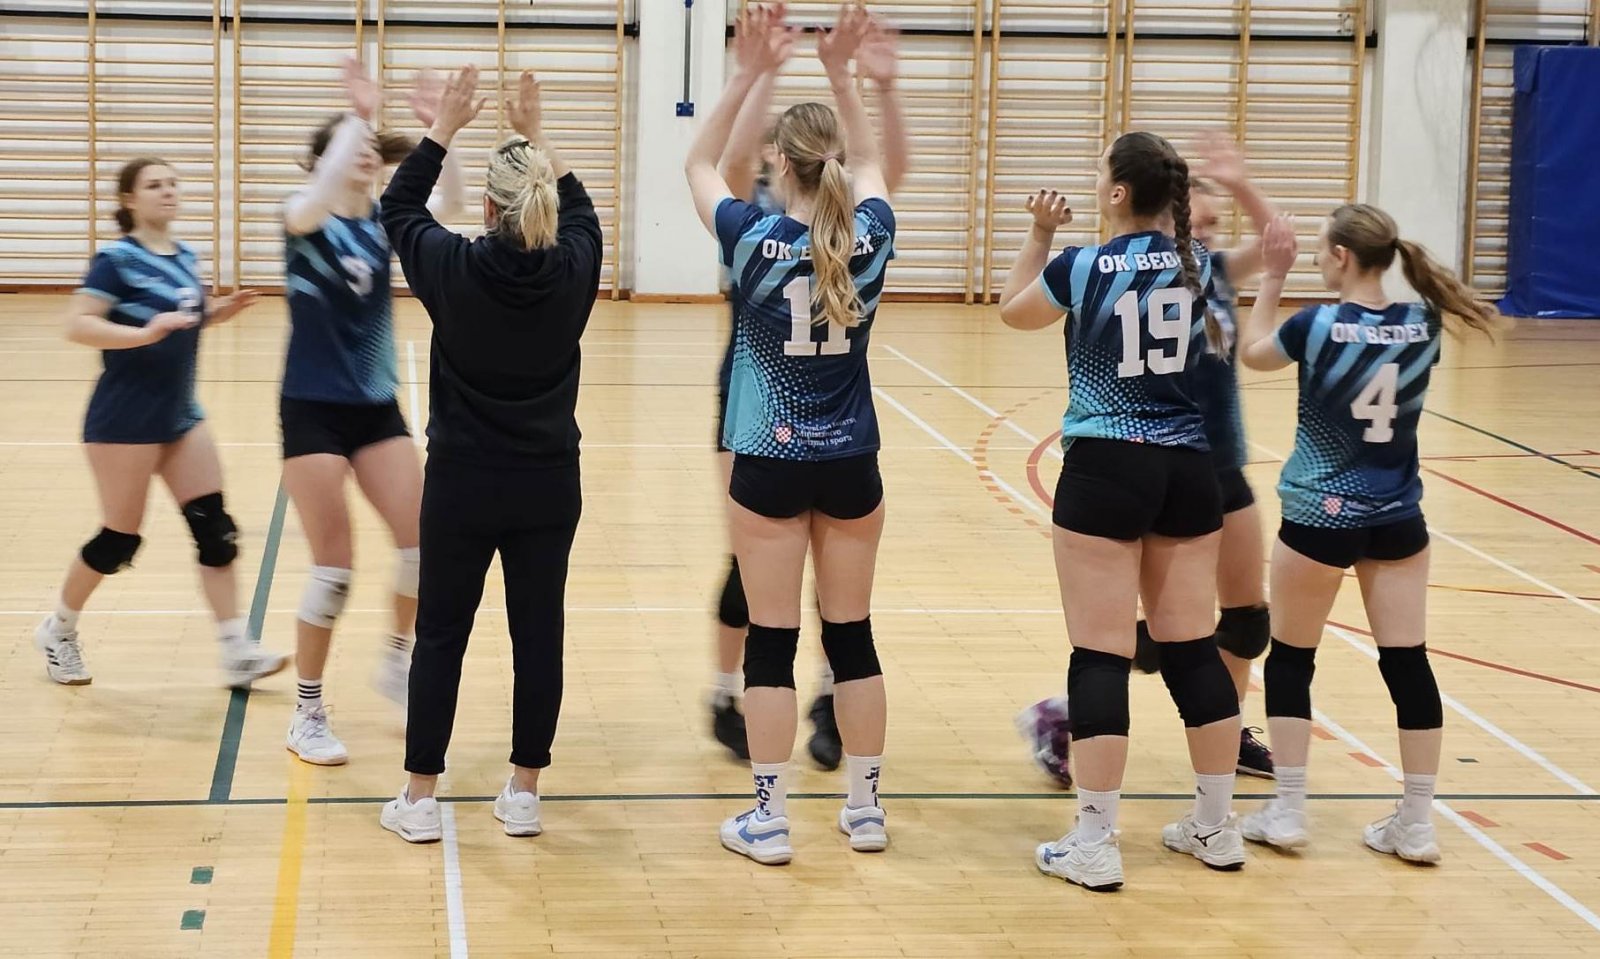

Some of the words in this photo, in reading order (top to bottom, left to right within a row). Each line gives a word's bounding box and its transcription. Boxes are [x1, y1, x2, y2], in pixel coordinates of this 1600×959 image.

[762, 239, 792, 260] OK
[800, 235, 874, 261] BEX
[1098, 255, 1131, 274] OK
[1134, 251, 1201, 271] BED
[1113, 287, 1193, 378] 19
[1331, 322, 1360, 343] OK
[1364, 322, 1430, 345] BEDEX
[1351, 362, 1400, 443] 4
